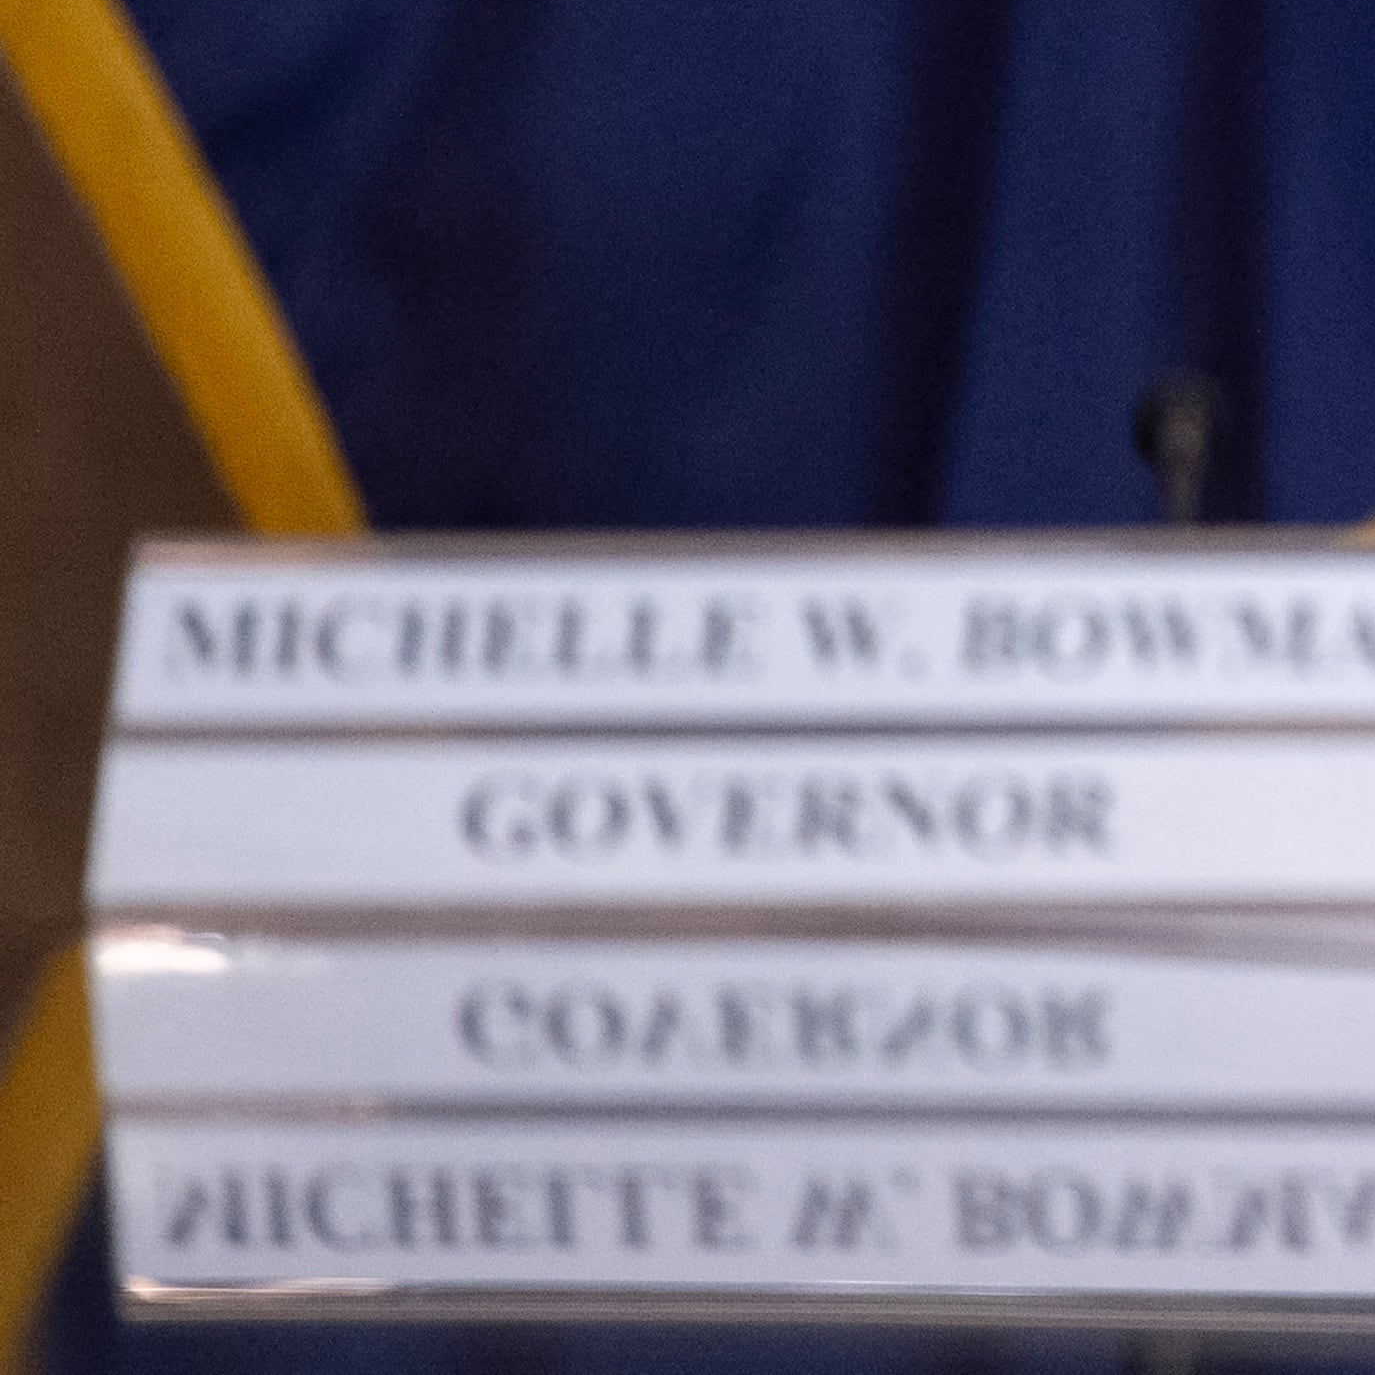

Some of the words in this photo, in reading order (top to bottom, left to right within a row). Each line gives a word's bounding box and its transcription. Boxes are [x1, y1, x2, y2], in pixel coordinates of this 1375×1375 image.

[168, 592, 765, 681] MICHELLE
[795, 592, 924, 679] W.
[455, 771, 1116, 863] GOVERNOR
